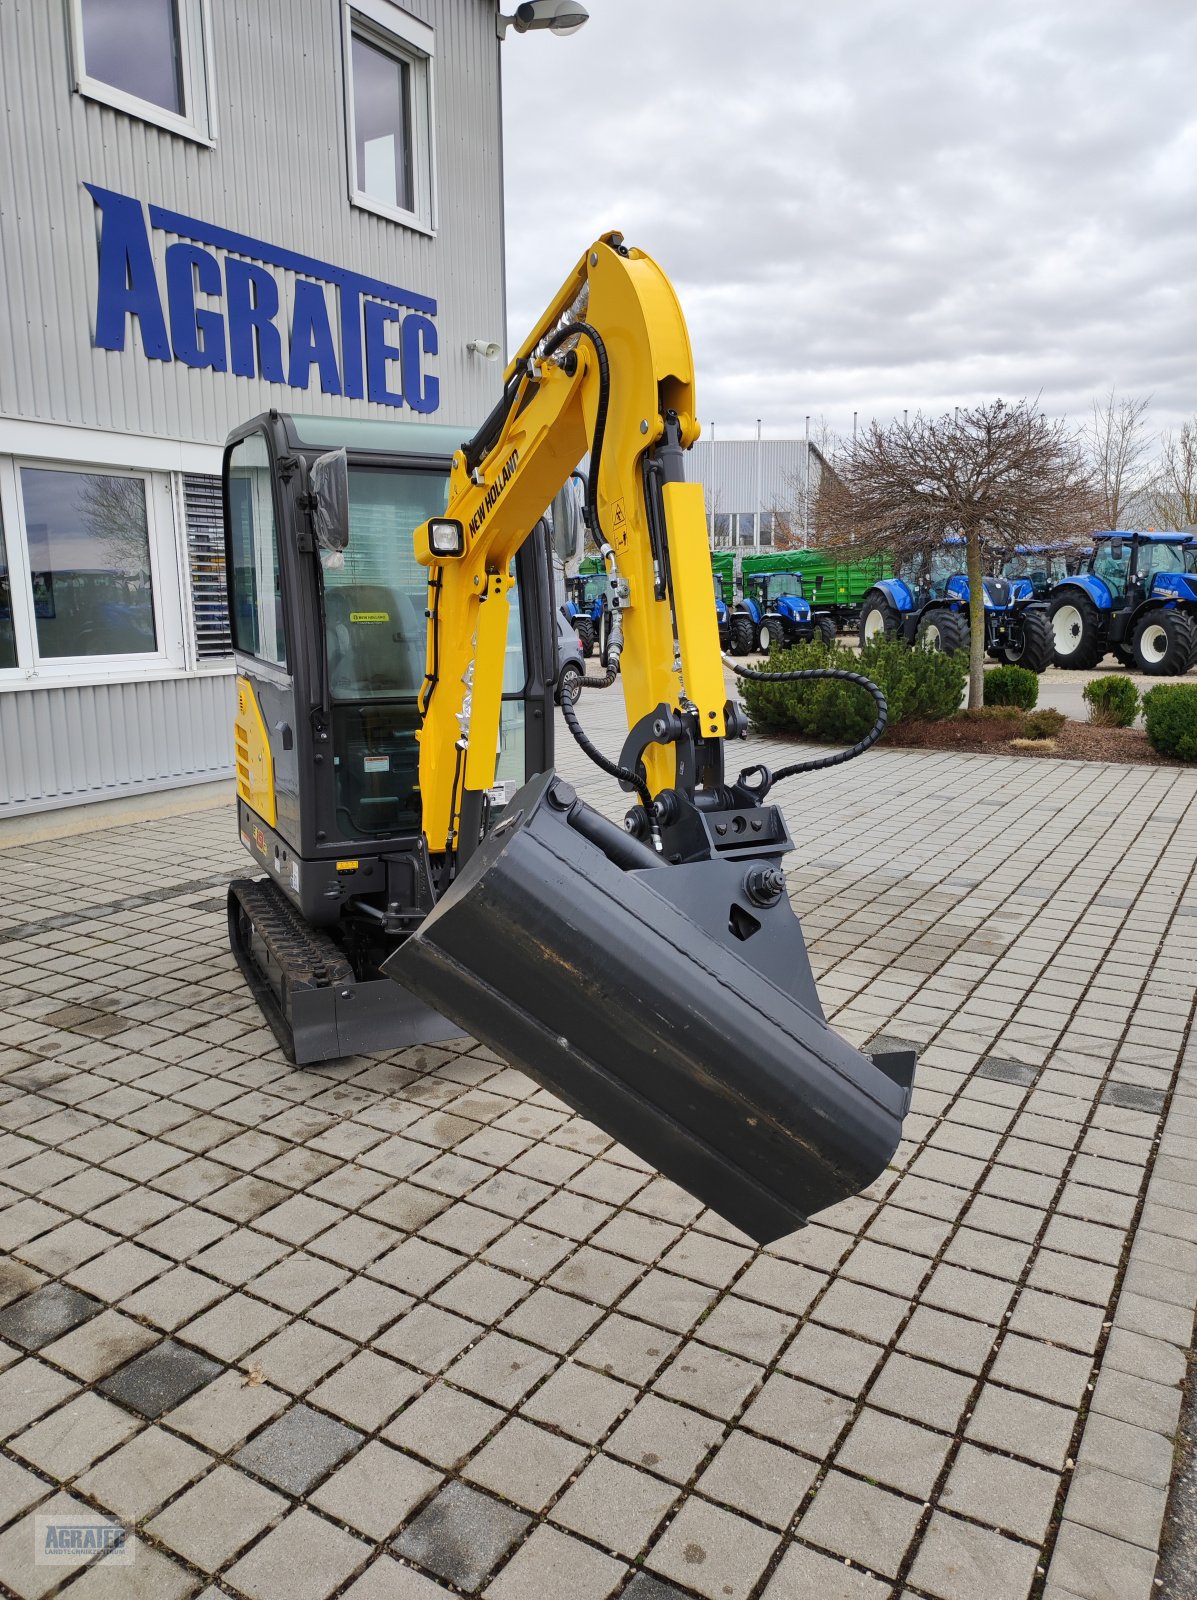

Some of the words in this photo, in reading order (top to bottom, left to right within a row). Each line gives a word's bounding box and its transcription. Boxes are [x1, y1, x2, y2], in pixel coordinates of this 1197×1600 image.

[83, 182, 440, 414] AGRATEC
[469, 502, 486, 539] NEW
[484, 448, 519, 513] HOLLAND
